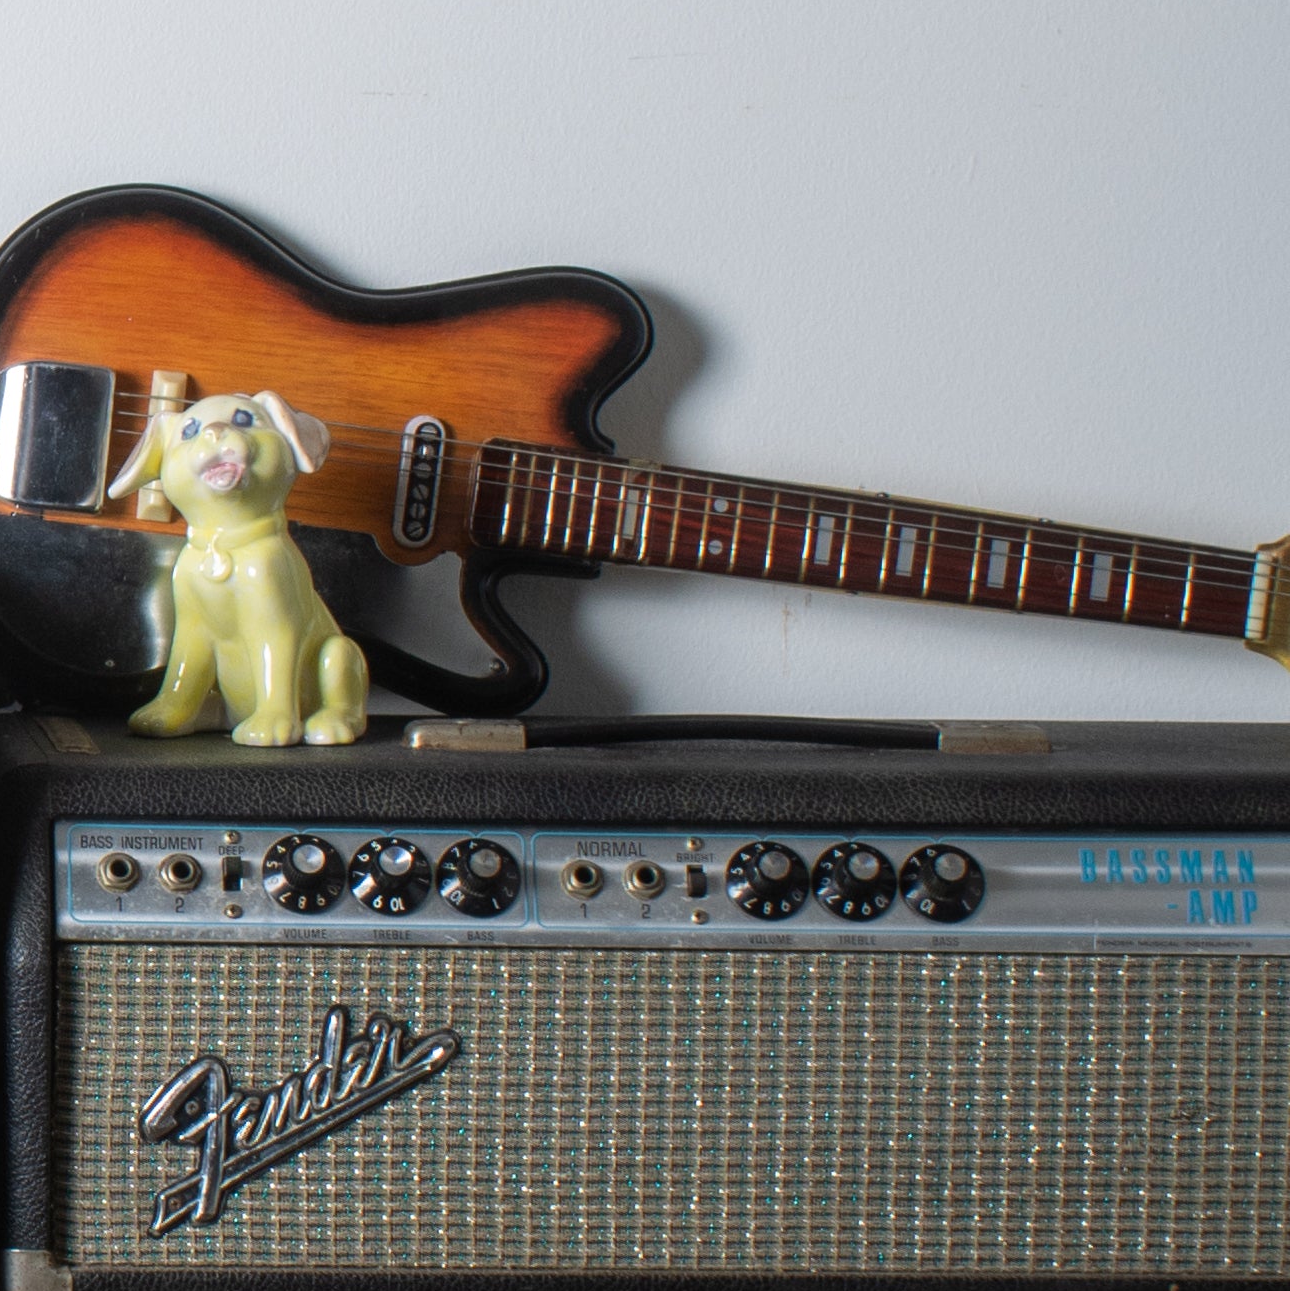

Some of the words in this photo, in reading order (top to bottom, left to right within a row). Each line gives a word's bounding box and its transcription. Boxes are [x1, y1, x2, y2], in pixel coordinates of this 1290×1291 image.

[80, 835, 114, 850] BASS
[121, 836, 204, 851] INSTRUMENT
[577, 841, 647, 857] NORMAL
[218, 845, 245, 857] DEEP
[676, 852, 715, 863] BRIGHT
[1079, 849, 1255, 884] BASSMAN
[283, 929, 327, 940] VOLUME
[372, 929, 411, 941] TREBLE
[467, 930, 494, 941] BASS
[748, 934, 794, 946] VOLUME
[837, 935, 878, 946] TREBLE
[932, 935, 959, 947] BASS
[140, 1004, 462, 1239] Fender
